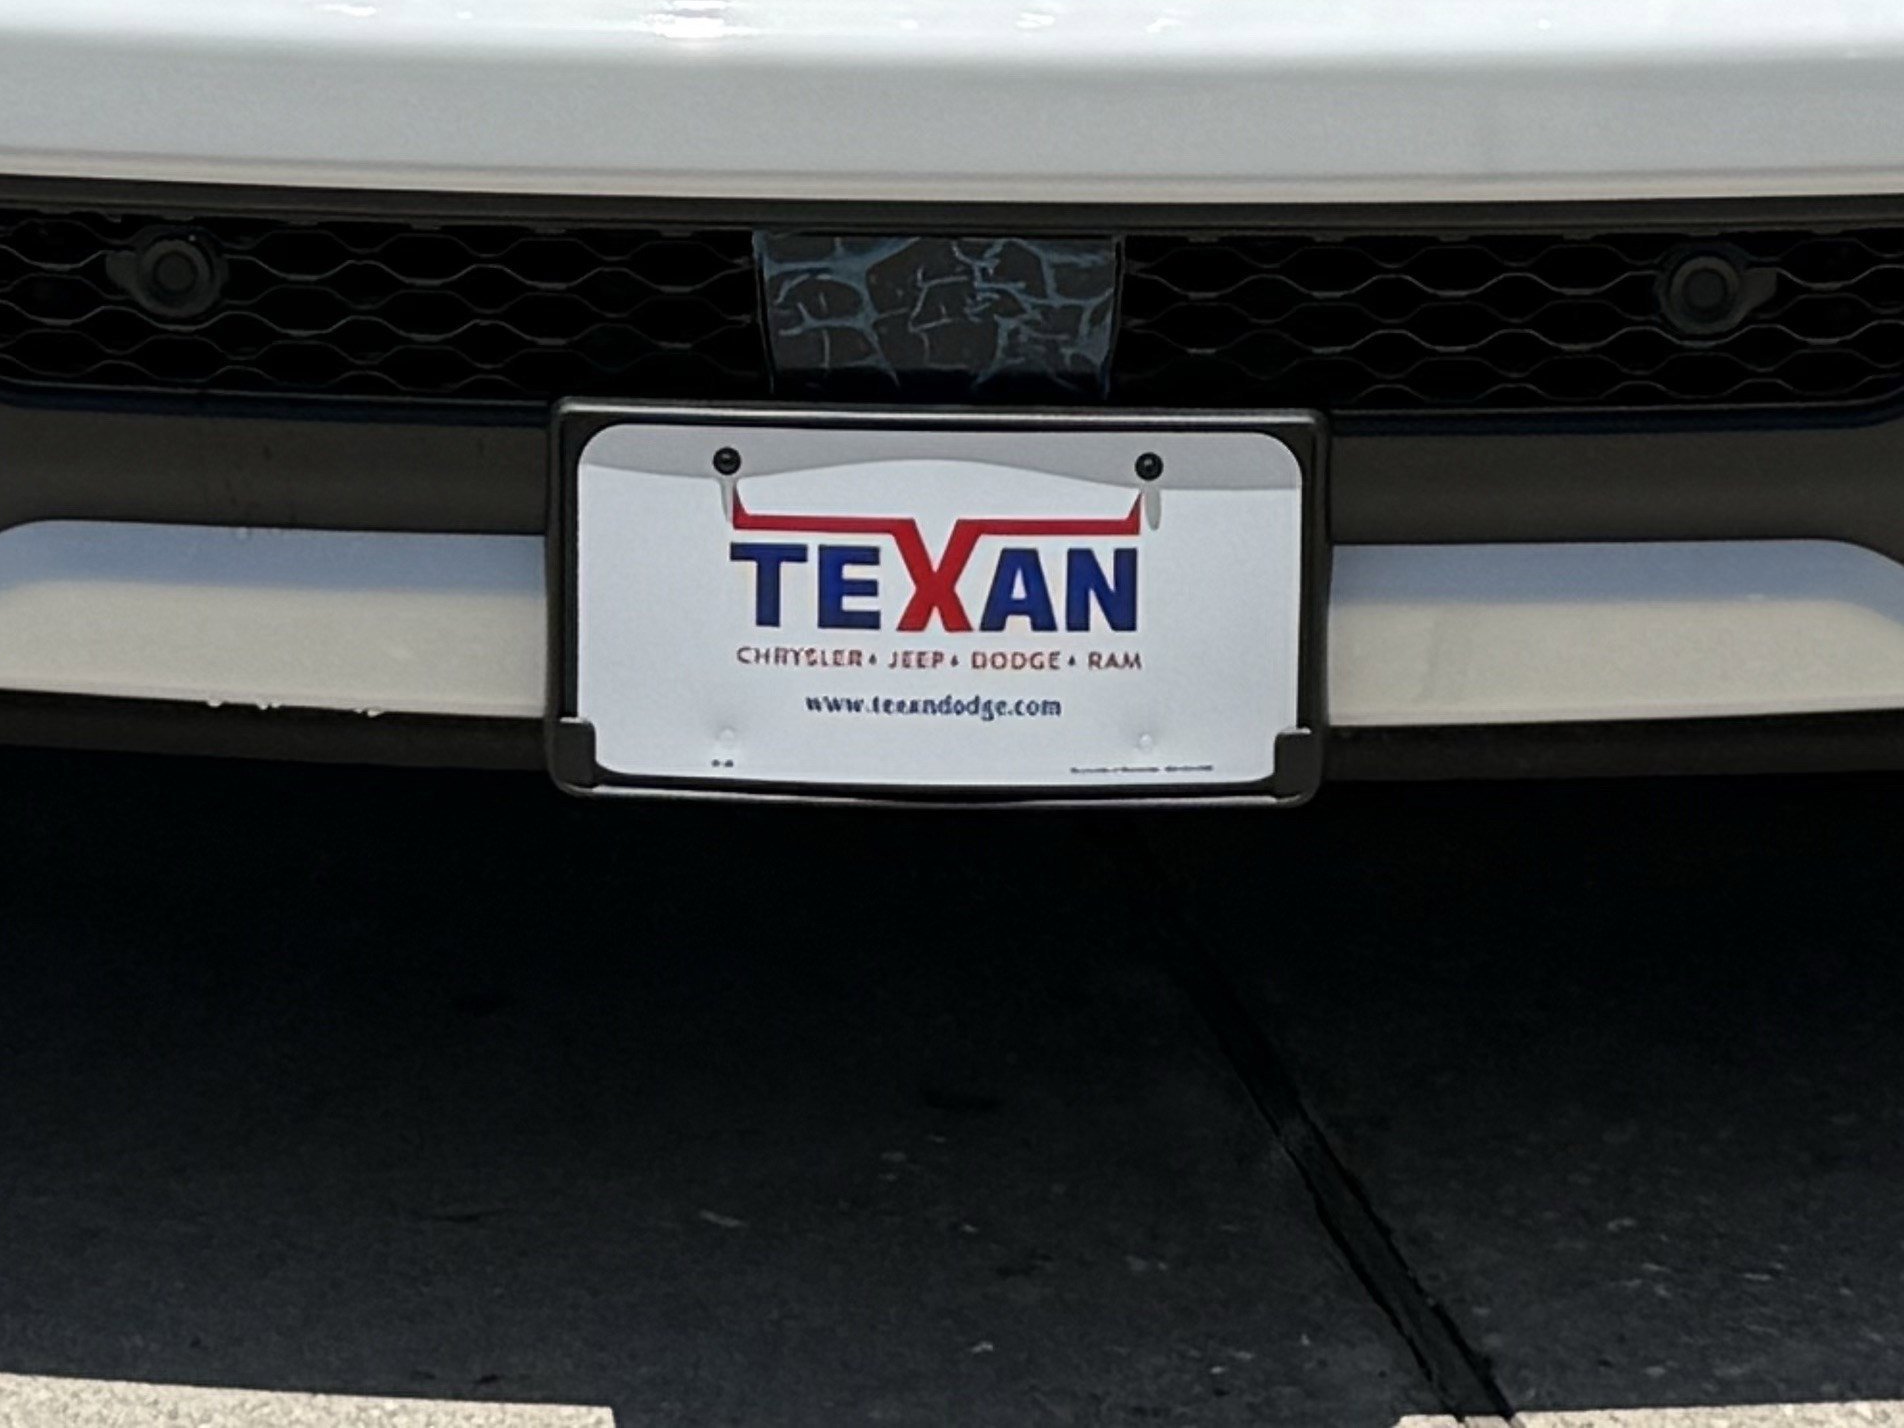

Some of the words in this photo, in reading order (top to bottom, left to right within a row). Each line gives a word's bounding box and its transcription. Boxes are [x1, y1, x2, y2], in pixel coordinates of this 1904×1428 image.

[728, 518, 1138, 633] TEXAN
[736, 646, 863, 667] CHRYSLER
[887, 650, 946, 670] JEEP
[971, 650, 1062, 671] DODGE
[1087, 652, 1143, 671] RAM
